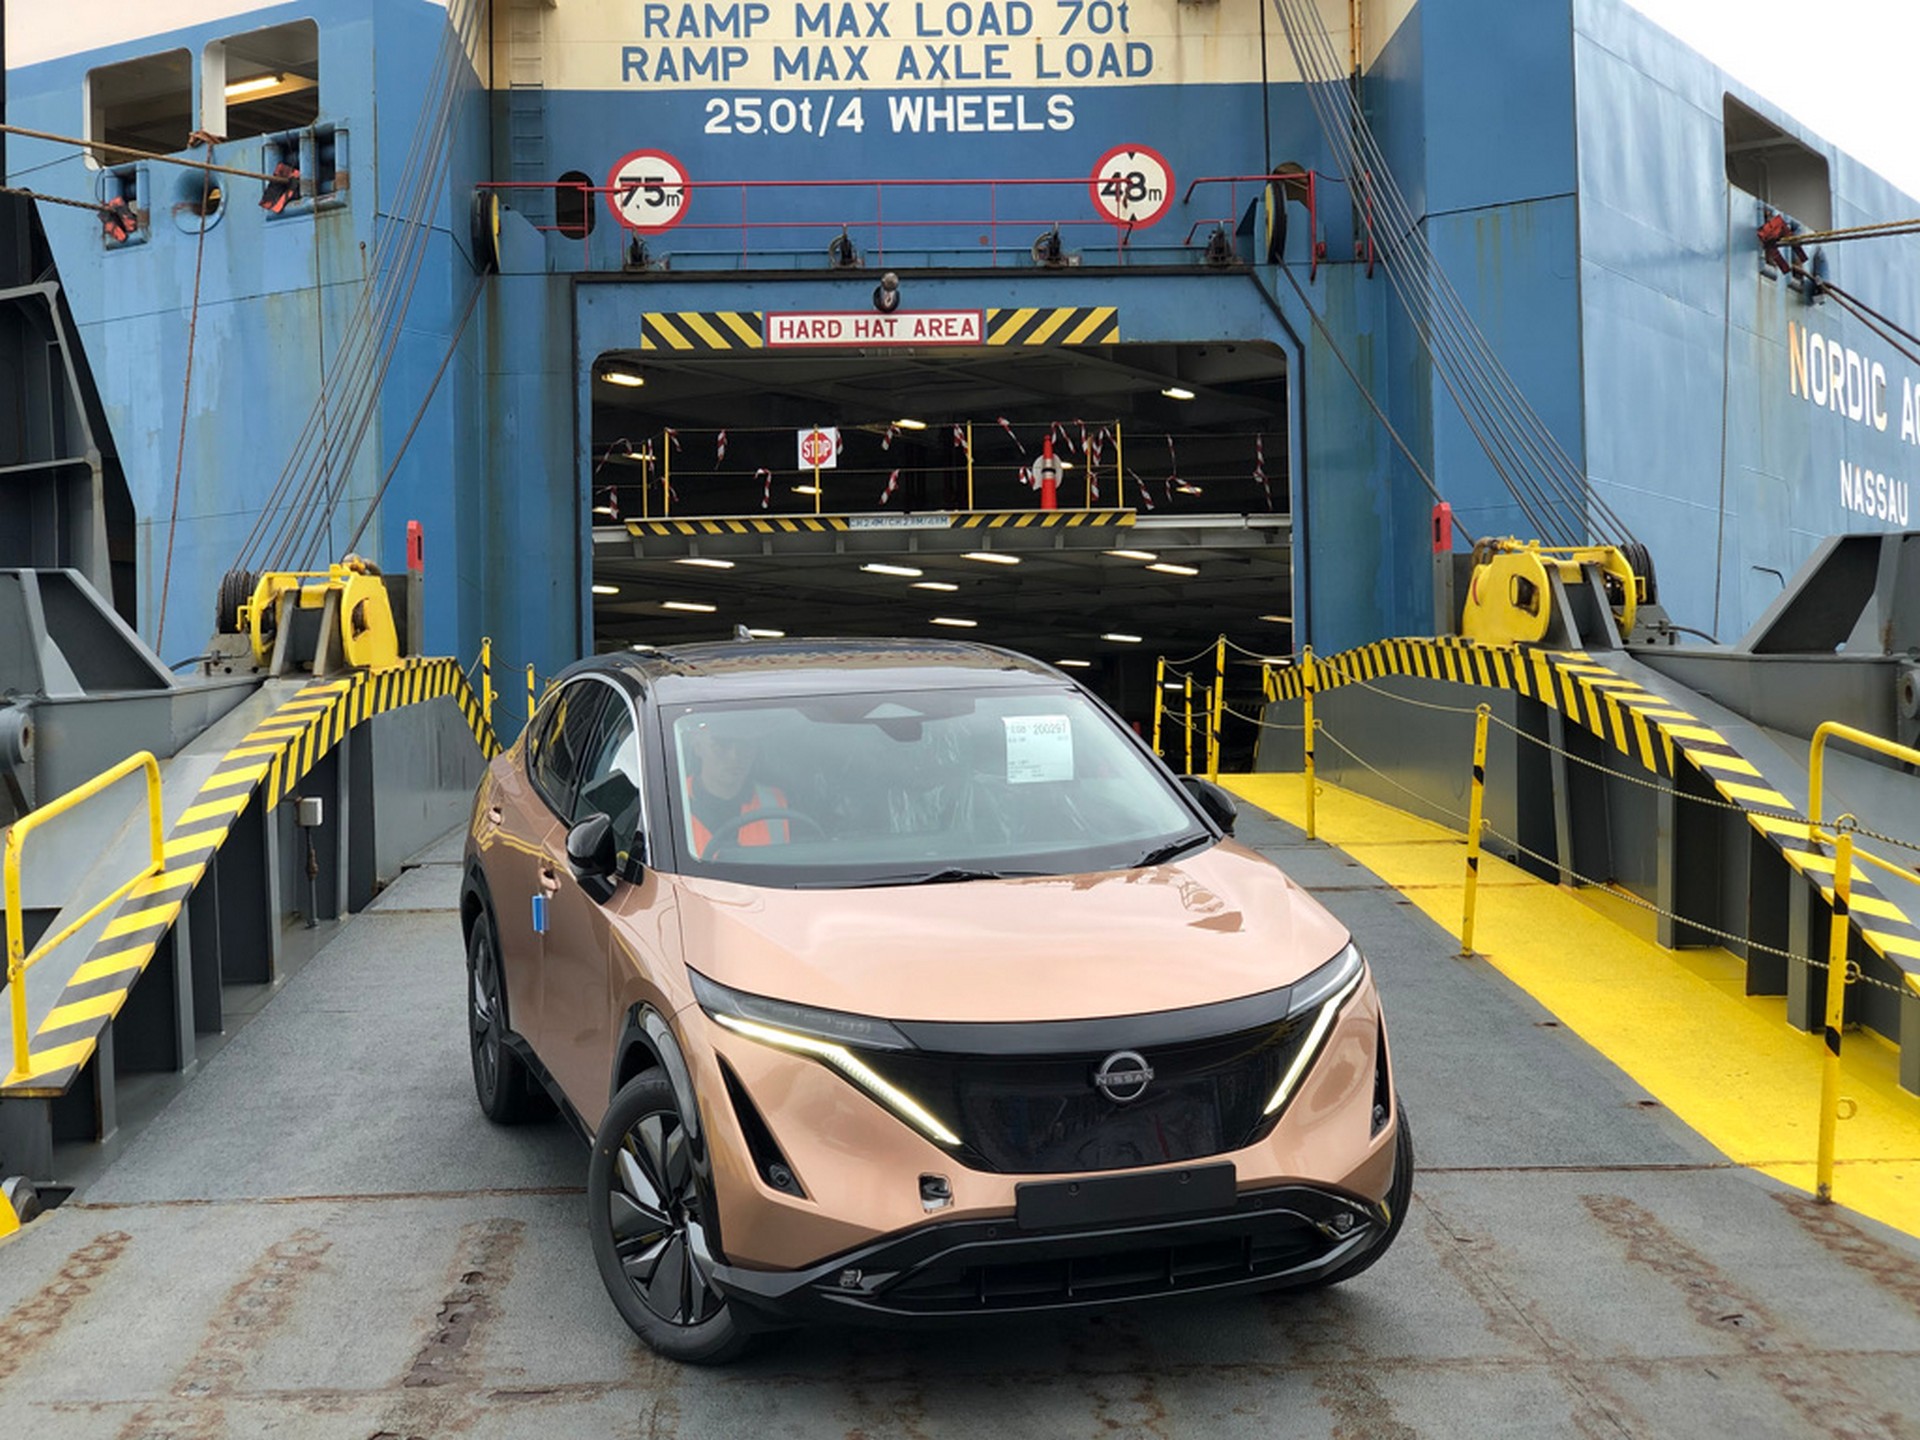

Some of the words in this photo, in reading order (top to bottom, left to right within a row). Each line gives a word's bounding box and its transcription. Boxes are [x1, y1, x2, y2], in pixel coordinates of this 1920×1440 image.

[644, 3, 770, 38] RAMP
[796, 2, 891, 38] MAX
[915, 1, 1034, 37] LOAD
[1057, 0, 1130, 35] 70t
[621, 45, 749, 82] RAMP
[773, 45, 869, 81] MAX
[896, 44, 1011, 80] AXLE
[1036, 42, 1153, 79] LOAD
[888, 94, 1075, 133] WHEELS
[779, 319, 842, 339] HARD
[855, 318, 898, 338] HAT
[914, 317, 974, 337] AREA
[1789, 321, 1887, 431] NORDIC
[803, 439, 831, 458] STOP
[1840, 459, 1909, 526] NASSAU
[1095, 1068, 1154, 1086] NISSAN
